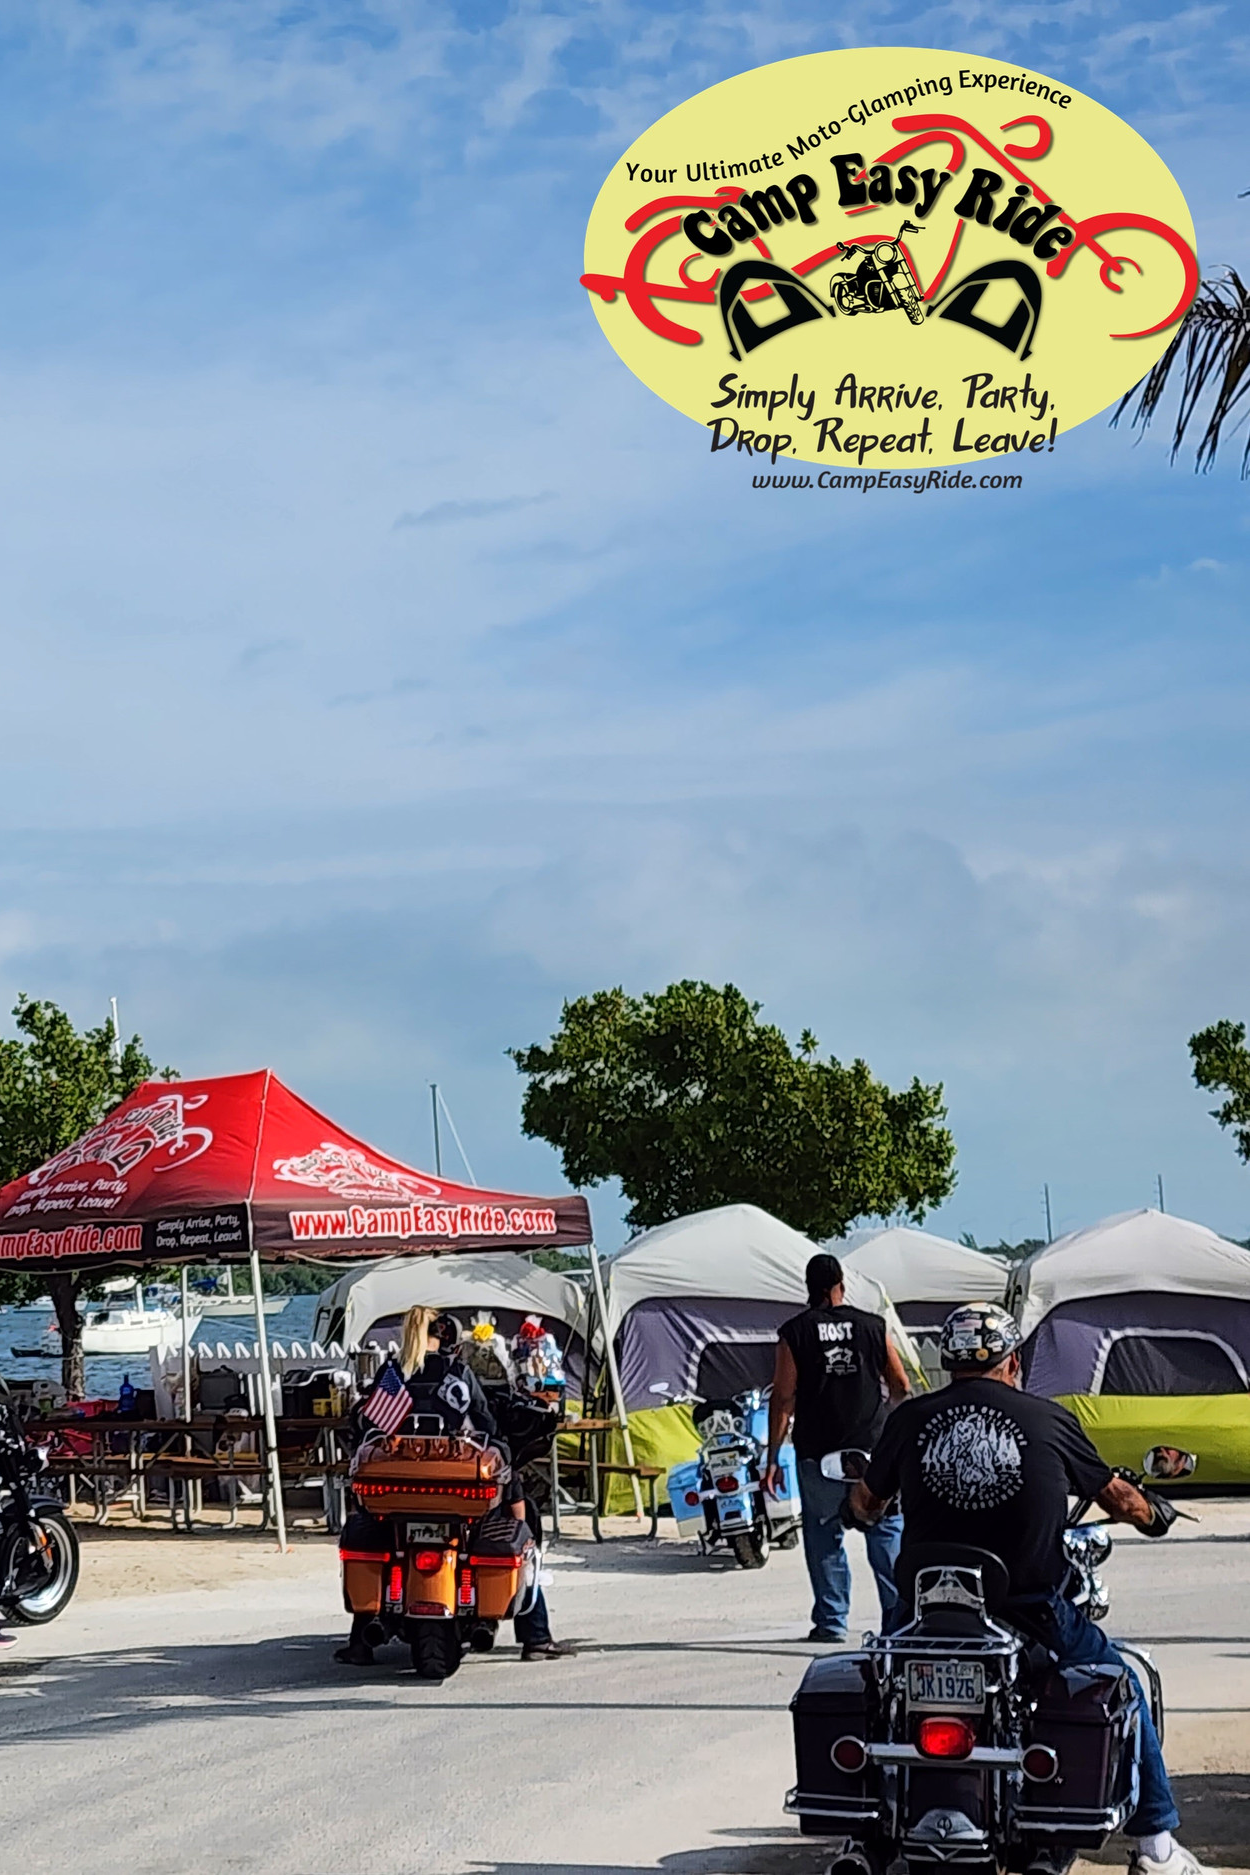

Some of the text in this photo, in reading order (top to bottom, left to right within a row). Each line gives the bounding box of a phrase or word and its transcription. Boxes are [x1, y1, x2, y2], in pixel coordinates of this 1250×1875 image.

[91, 1178, 128, 1194] Party,
[77, 1195, 122, 1210] Leave!
[155, 1218, 185, 1234] Simply
[215, 1214, 241, 1228] Party,
[288, 1203, 557, 1239] www.CampEasyRide.com
[155, 1235, 179, 1248] Drop,
[817, 1321, 853, 1342] HOST
